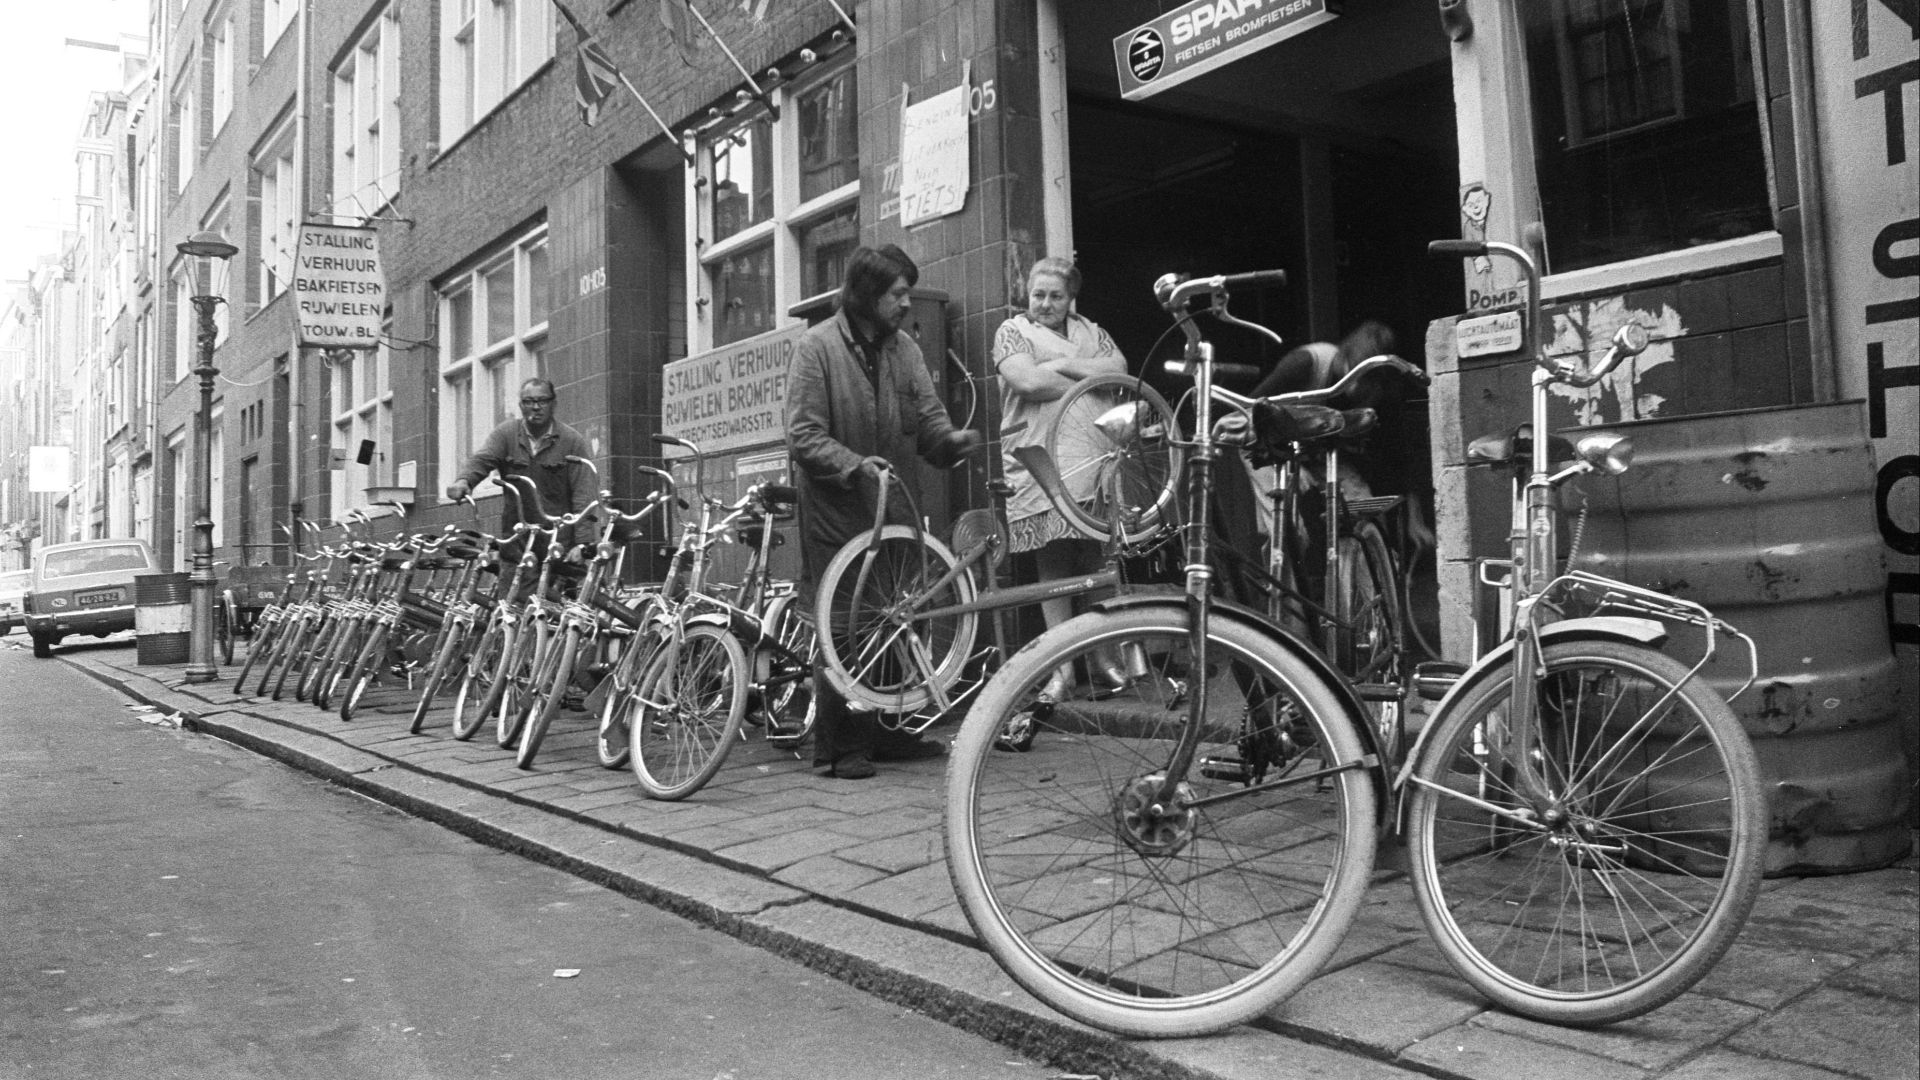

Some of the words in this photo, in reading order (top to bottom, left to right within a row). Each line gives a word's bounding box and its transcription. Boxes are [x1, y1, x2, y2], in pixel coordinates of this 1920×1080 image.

[1175, 35, 1221, 64] FIETSEN
[1225, 0, 1313, 42] BROMFIETSEN
[304, 232, 374, 250] STALLING
[301, 255, 376, 273] VERHUUR
[1470, 289, 1518, 310] POMP
[668, 360, 722, 397] STALLING
[666, 391, 722, 427] RIJWIELEN
